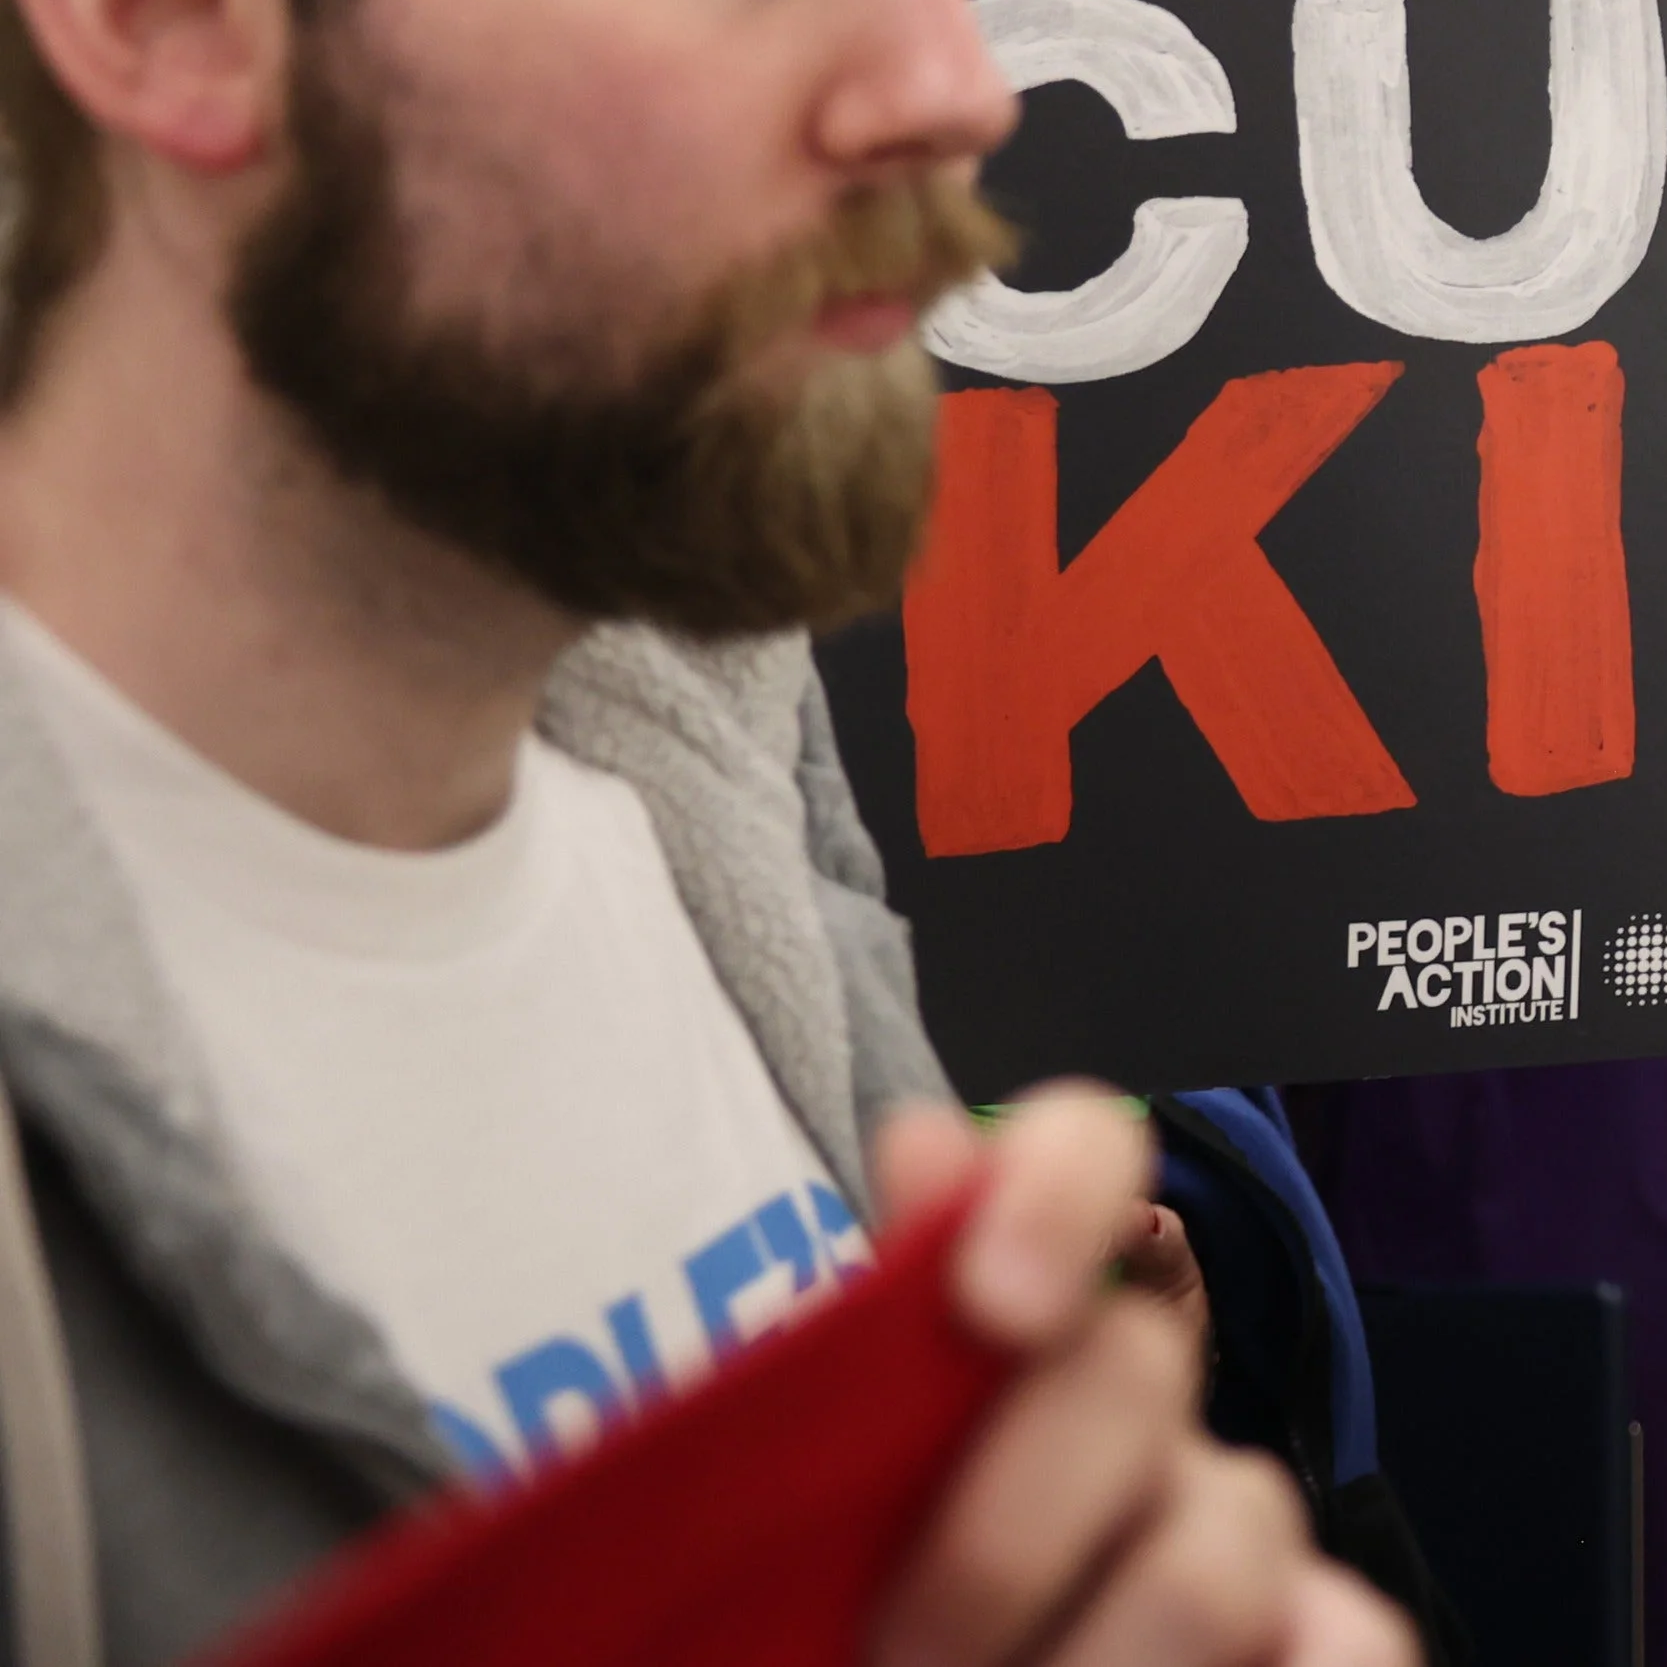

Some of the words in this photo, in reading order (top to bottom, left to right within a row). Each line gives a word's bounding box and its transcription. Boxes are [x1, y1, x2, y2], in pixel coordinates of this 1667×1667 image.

[1347, 911, 1566, 968] PEOPLE'S
[1376, 955, 1565, 1011] ACTION
[1450, 999, 1563, 1028] INSTITUTE
